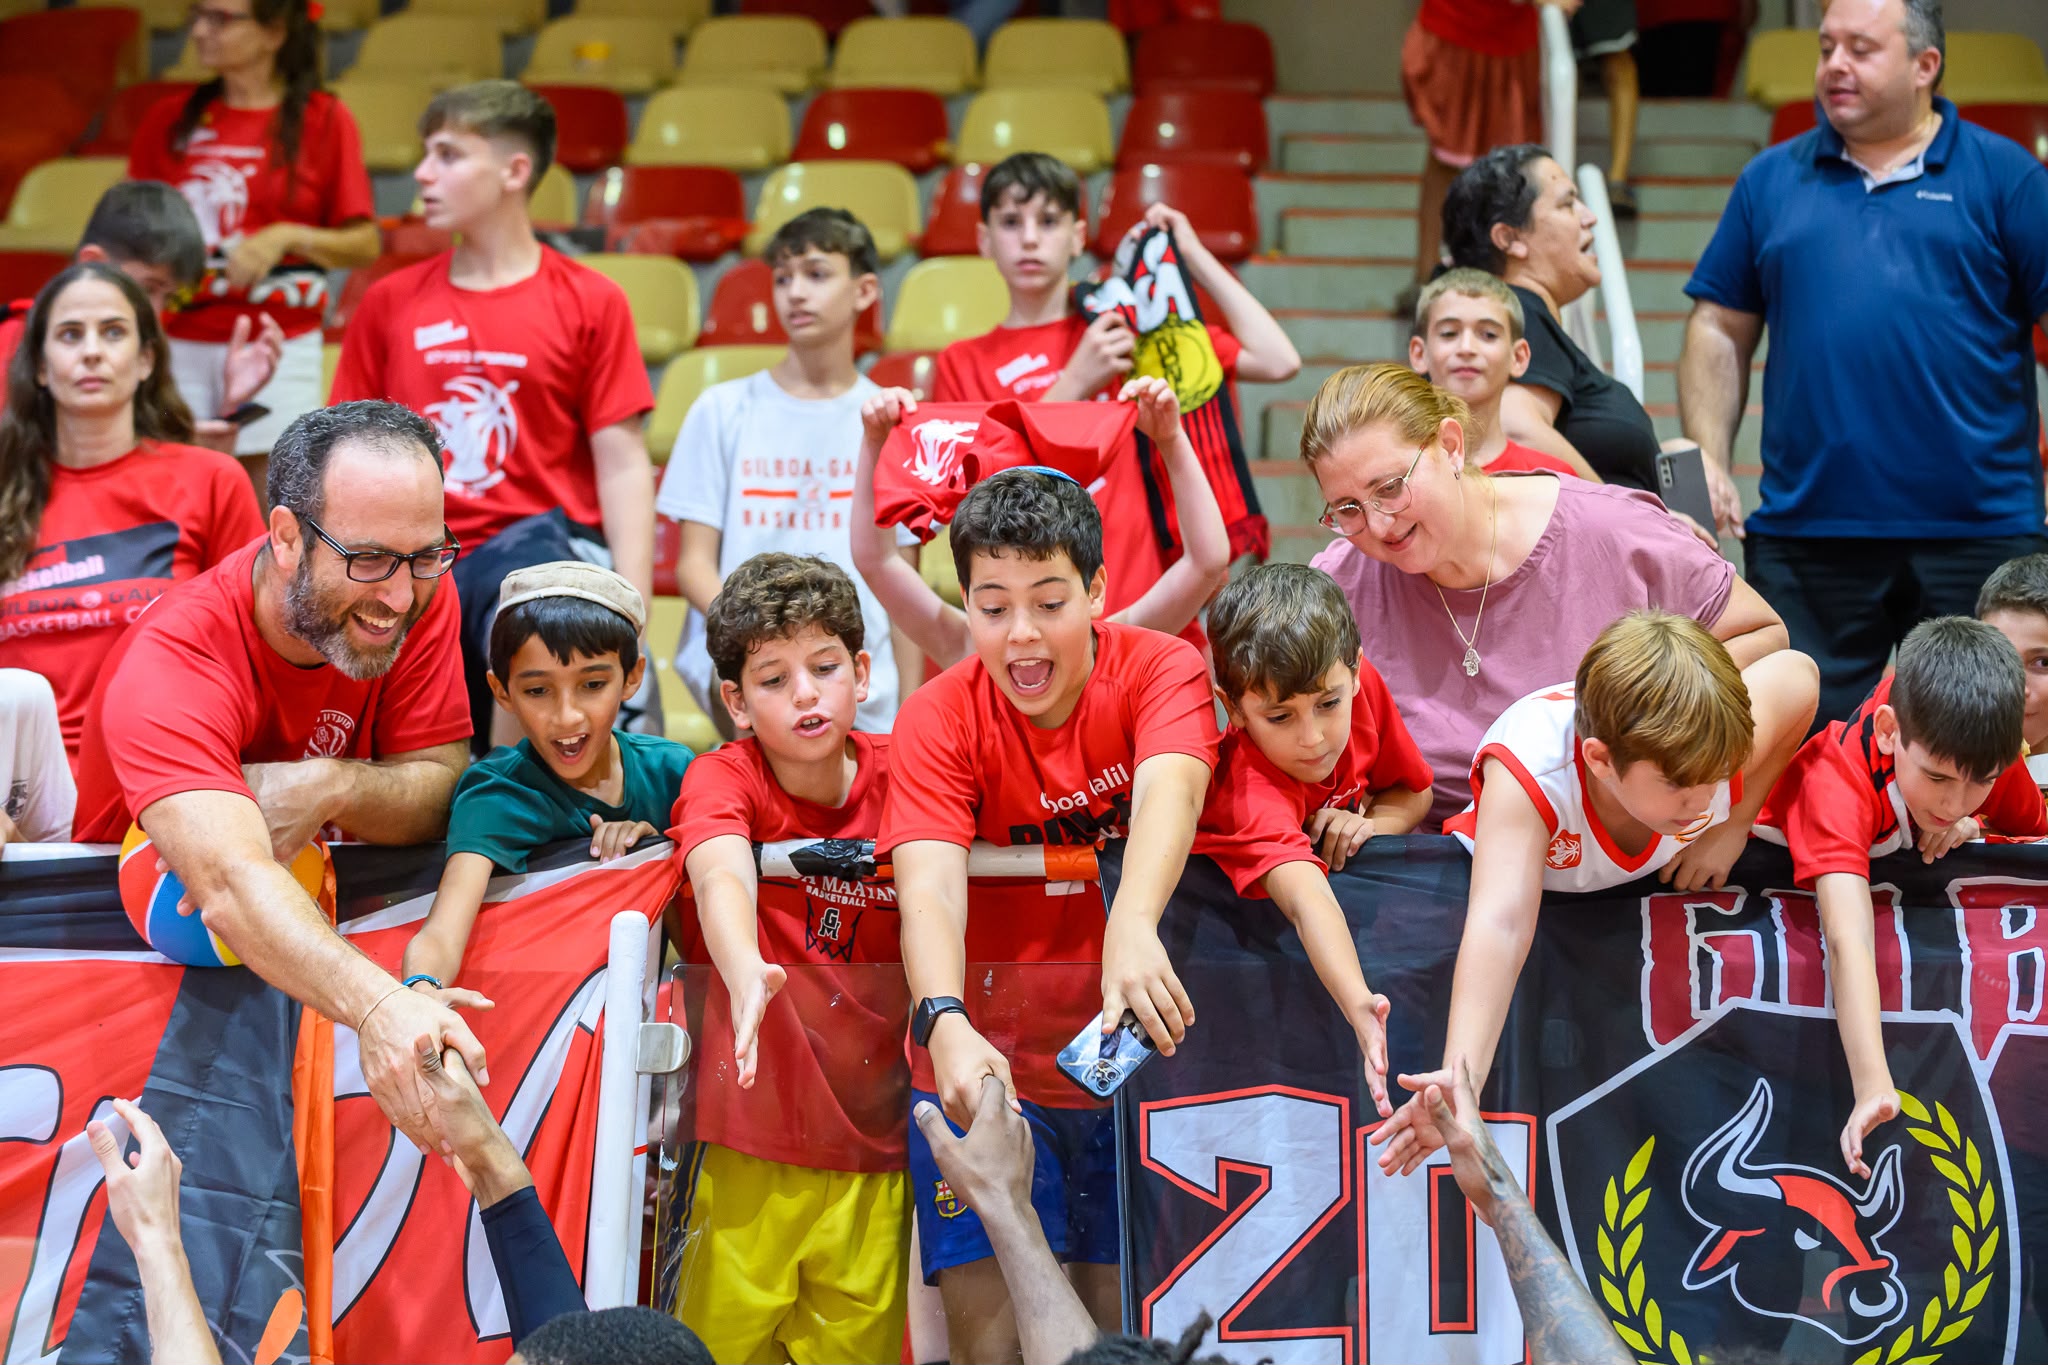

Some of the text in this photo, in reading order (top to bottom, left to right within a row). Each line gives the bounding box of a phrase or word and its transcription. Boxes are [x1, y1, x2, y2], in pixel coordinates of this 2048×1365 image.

[743, 458, 854, 478] GILBOA-GA
[743, 509, 841, 530] BASKETB
[805, 885, 867, 907] BASKETBALL
